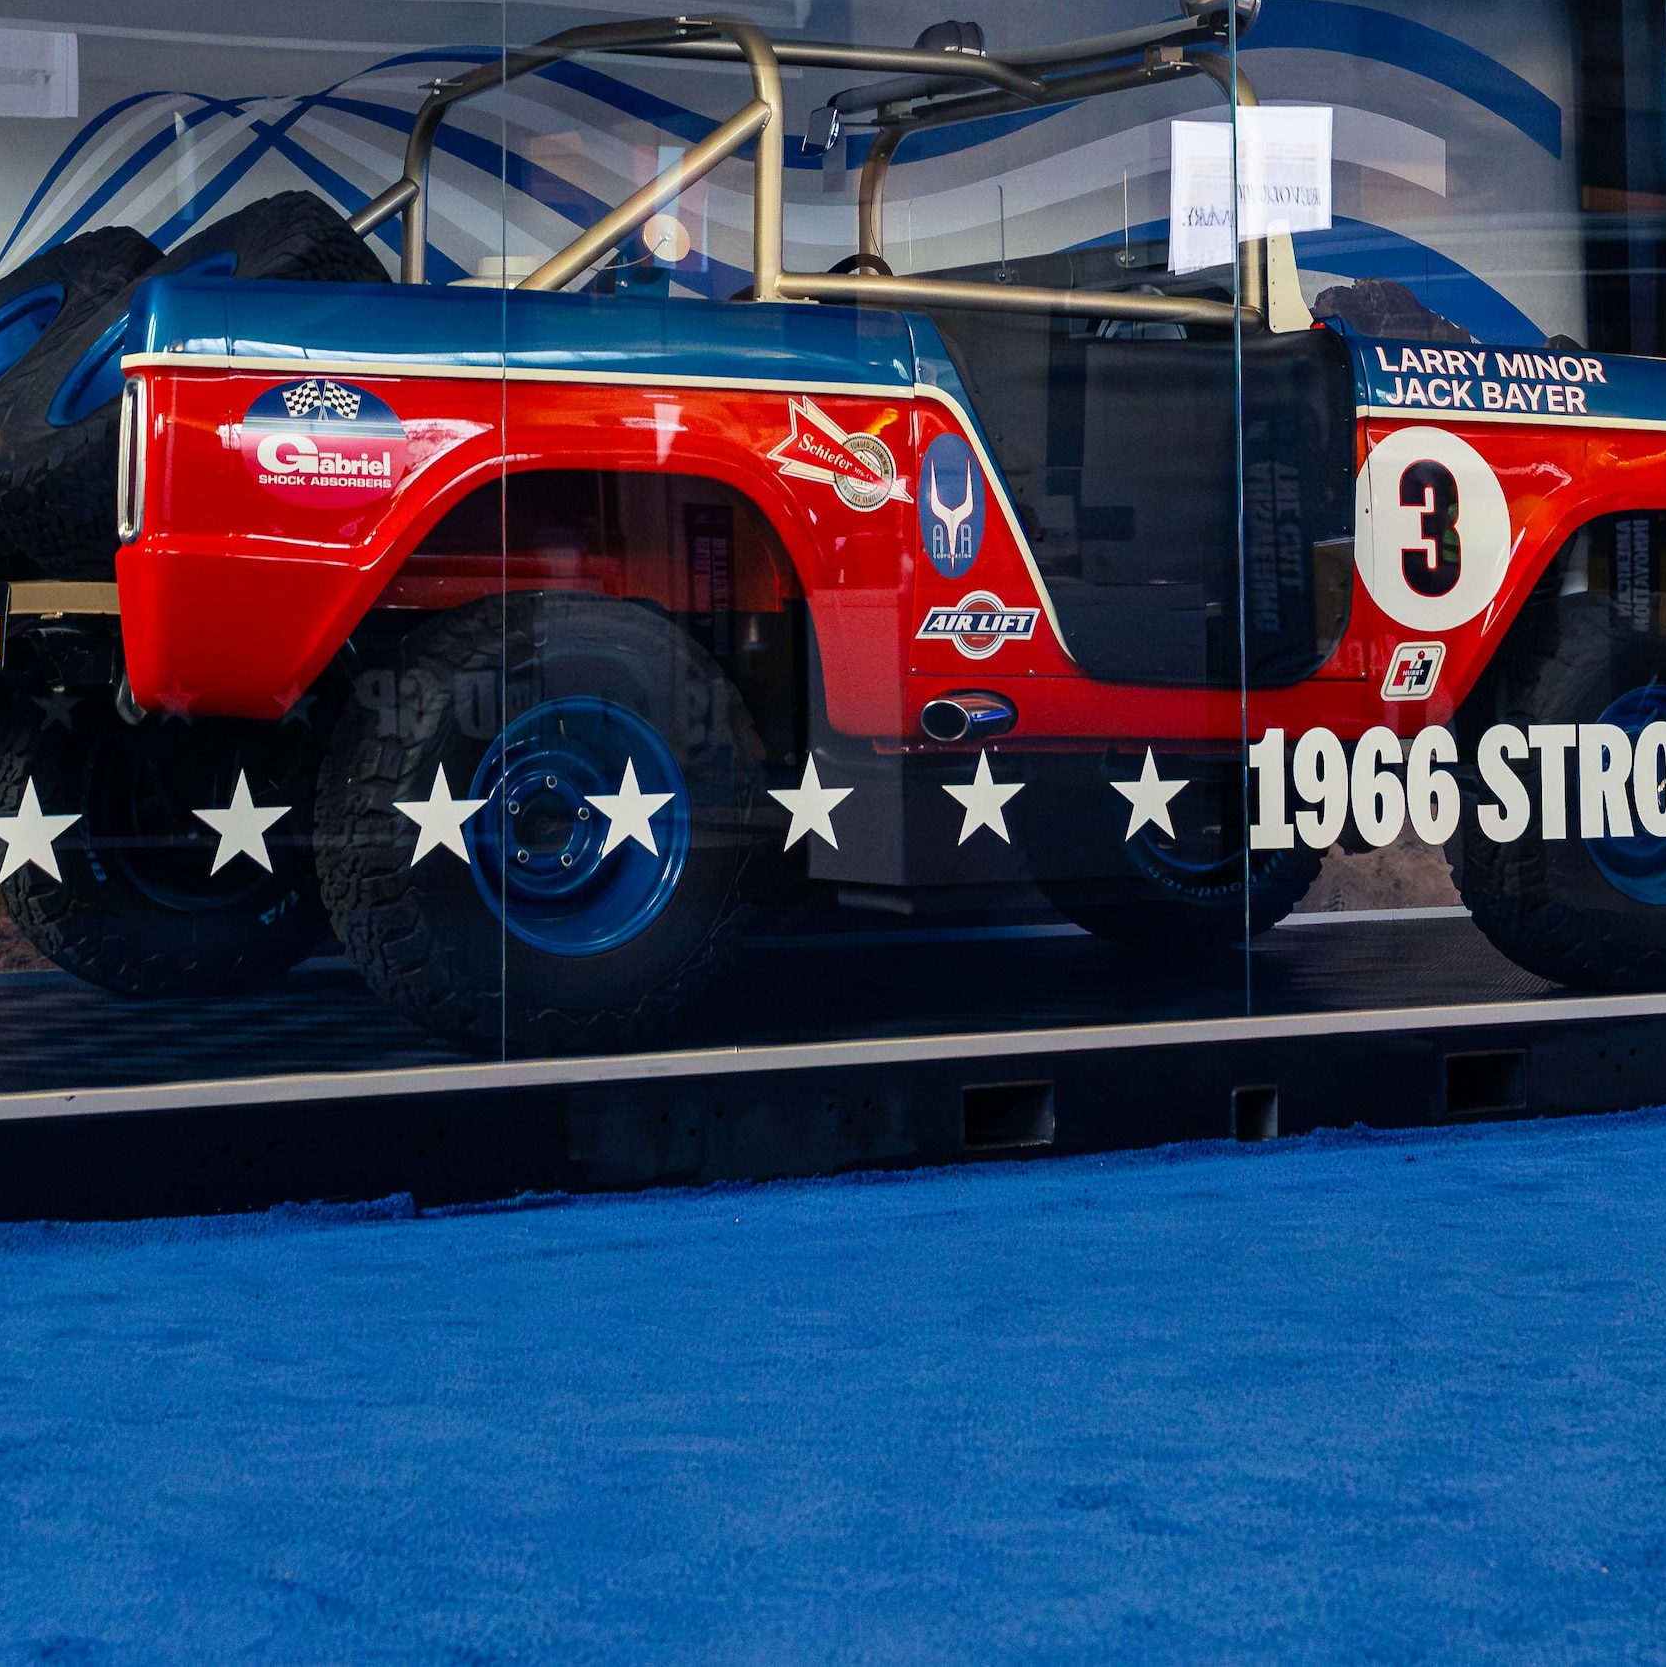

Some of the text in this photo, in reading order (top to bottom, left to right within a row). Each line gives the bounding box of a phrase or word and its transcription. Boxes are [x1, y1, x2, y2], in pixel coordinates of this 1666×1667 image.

[1375, 346, 1607, 384] LARRY MINOR
[1385, 377, 1588, 414] JACK BAYER
[797, 433, 853, 472] Schiefer
[258, 474, 392, 489] SHOCK ABSORBERS
[1399, 459, 1462, 598] 3
[928, 614, 1030, 632] AIR LIFT
[1248, 725, 1461, 850] 1966
